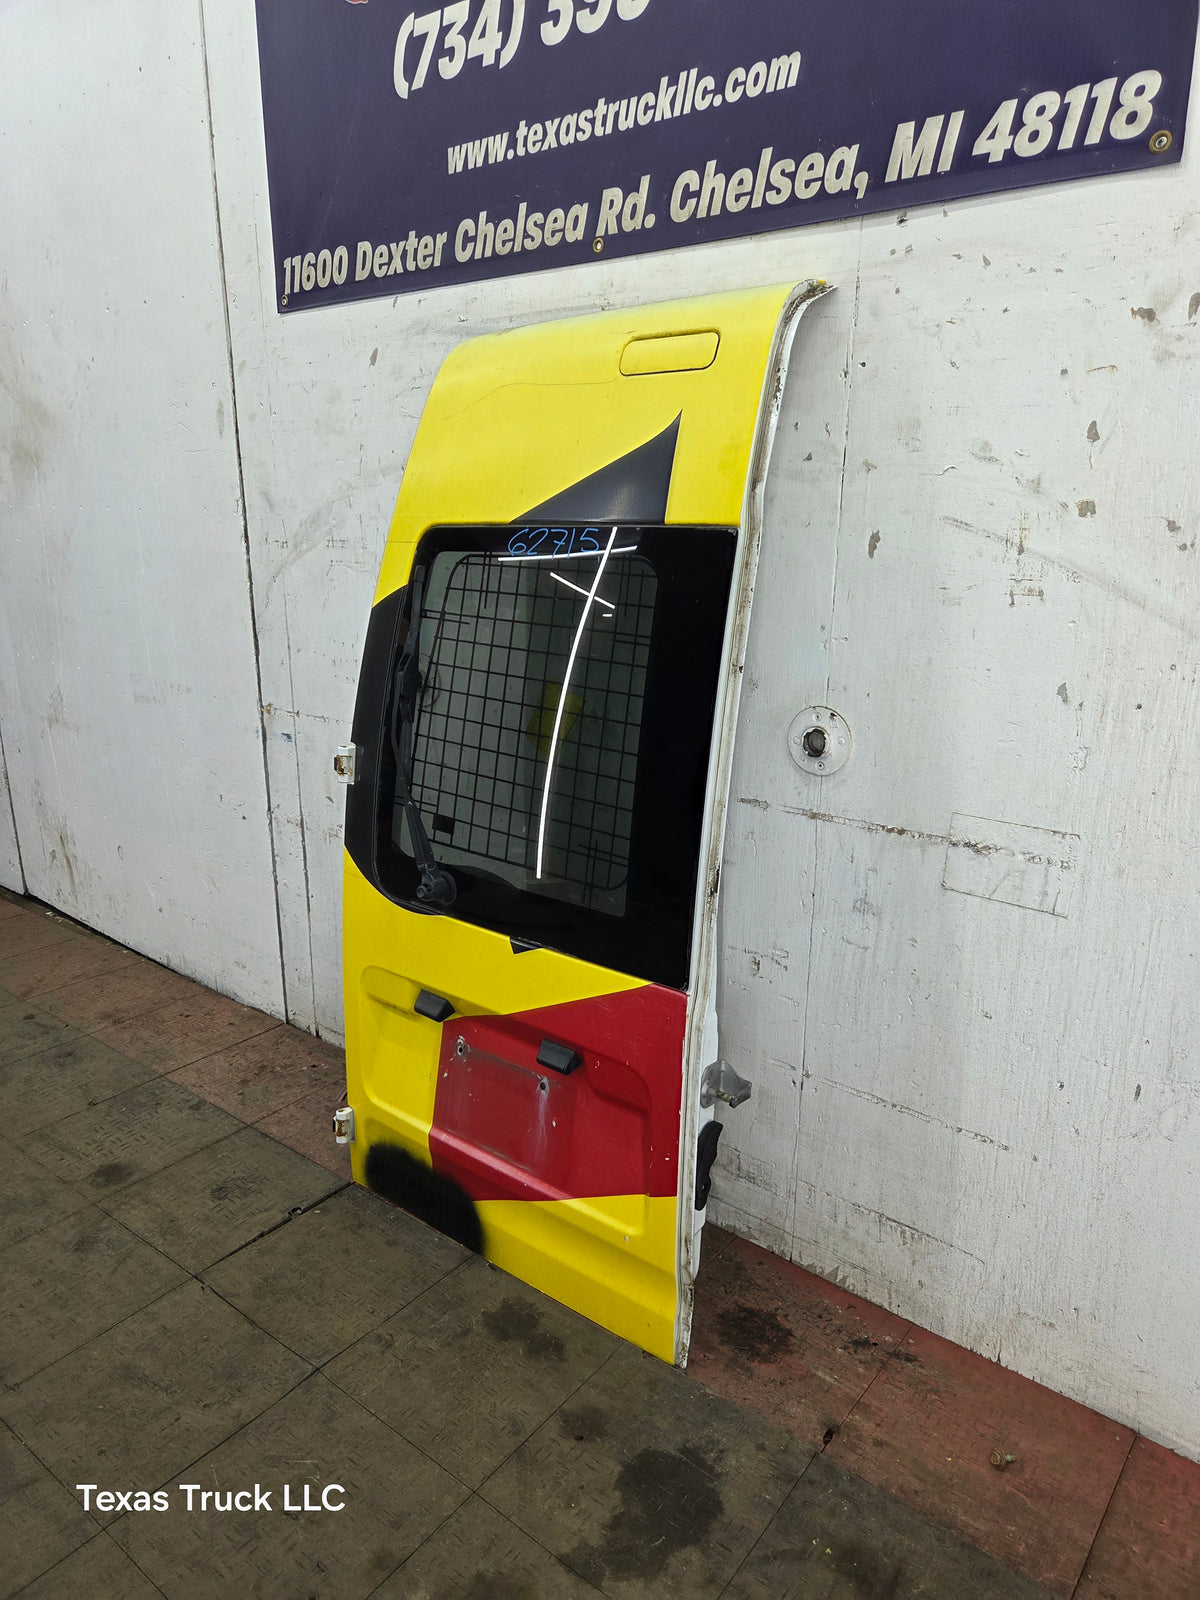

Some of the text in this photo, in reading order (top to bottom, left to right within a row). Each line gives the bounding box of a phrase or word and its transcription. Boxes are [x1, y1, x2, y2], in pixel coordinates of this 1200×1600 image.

[393, 0, 525, 100] (734)
[447, 51, 801, 174] www.texastruckllc.com
[283, 70, 1162, 294] 11600 Dexter Chelsea Rd. Chelsea, MI 48118
[507, 527, 600, 560] 62715
